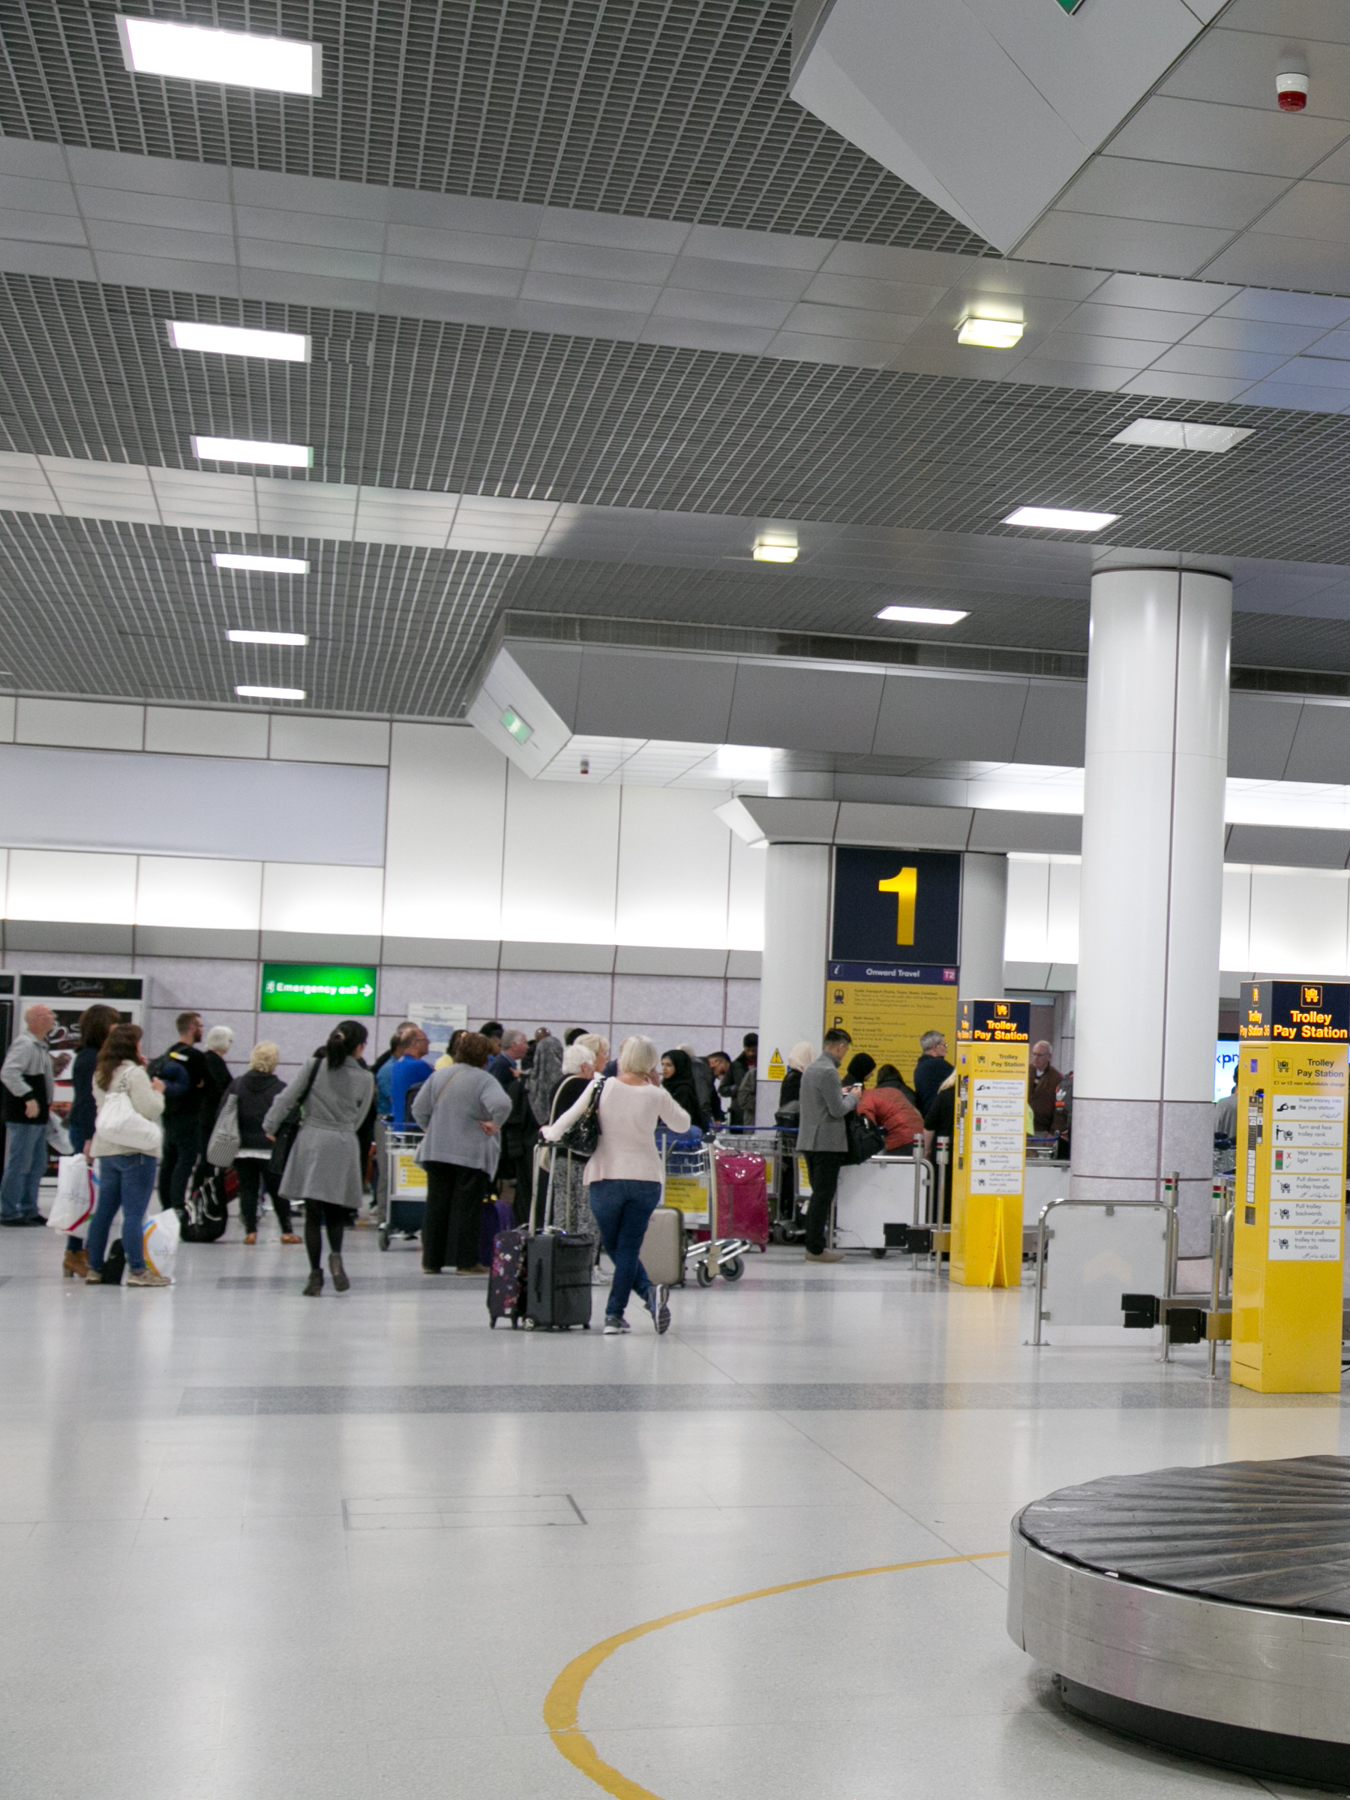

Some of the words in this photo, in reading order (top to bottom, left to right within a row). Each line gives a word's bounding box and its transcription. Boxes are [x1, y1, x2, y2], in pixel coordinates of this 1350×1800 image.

[879, 867, 918, 946] 1
[866, 968, 896, 976] Onward
[945, 971, 955, 979] T2
[276, 983, 337, 995] Emergency
[338, 986, 358, 995] exit
[1290, 1010, 1332, 1025] Trolley
[987, 1020, 1017, 1031] Trolley
[974, 1031, 991, 1041] Pay
[994, 1031, 1028, 1040] Station
[1273, 1024, 1297, 1039] Pay
[1302, 1025, 1348, 1039] Station
[1307, 1058, 1334, 1067] Trolley
[1297, 1069, 1313, 1078] Pay
[1315, 1069, 1344, 1078] Station
